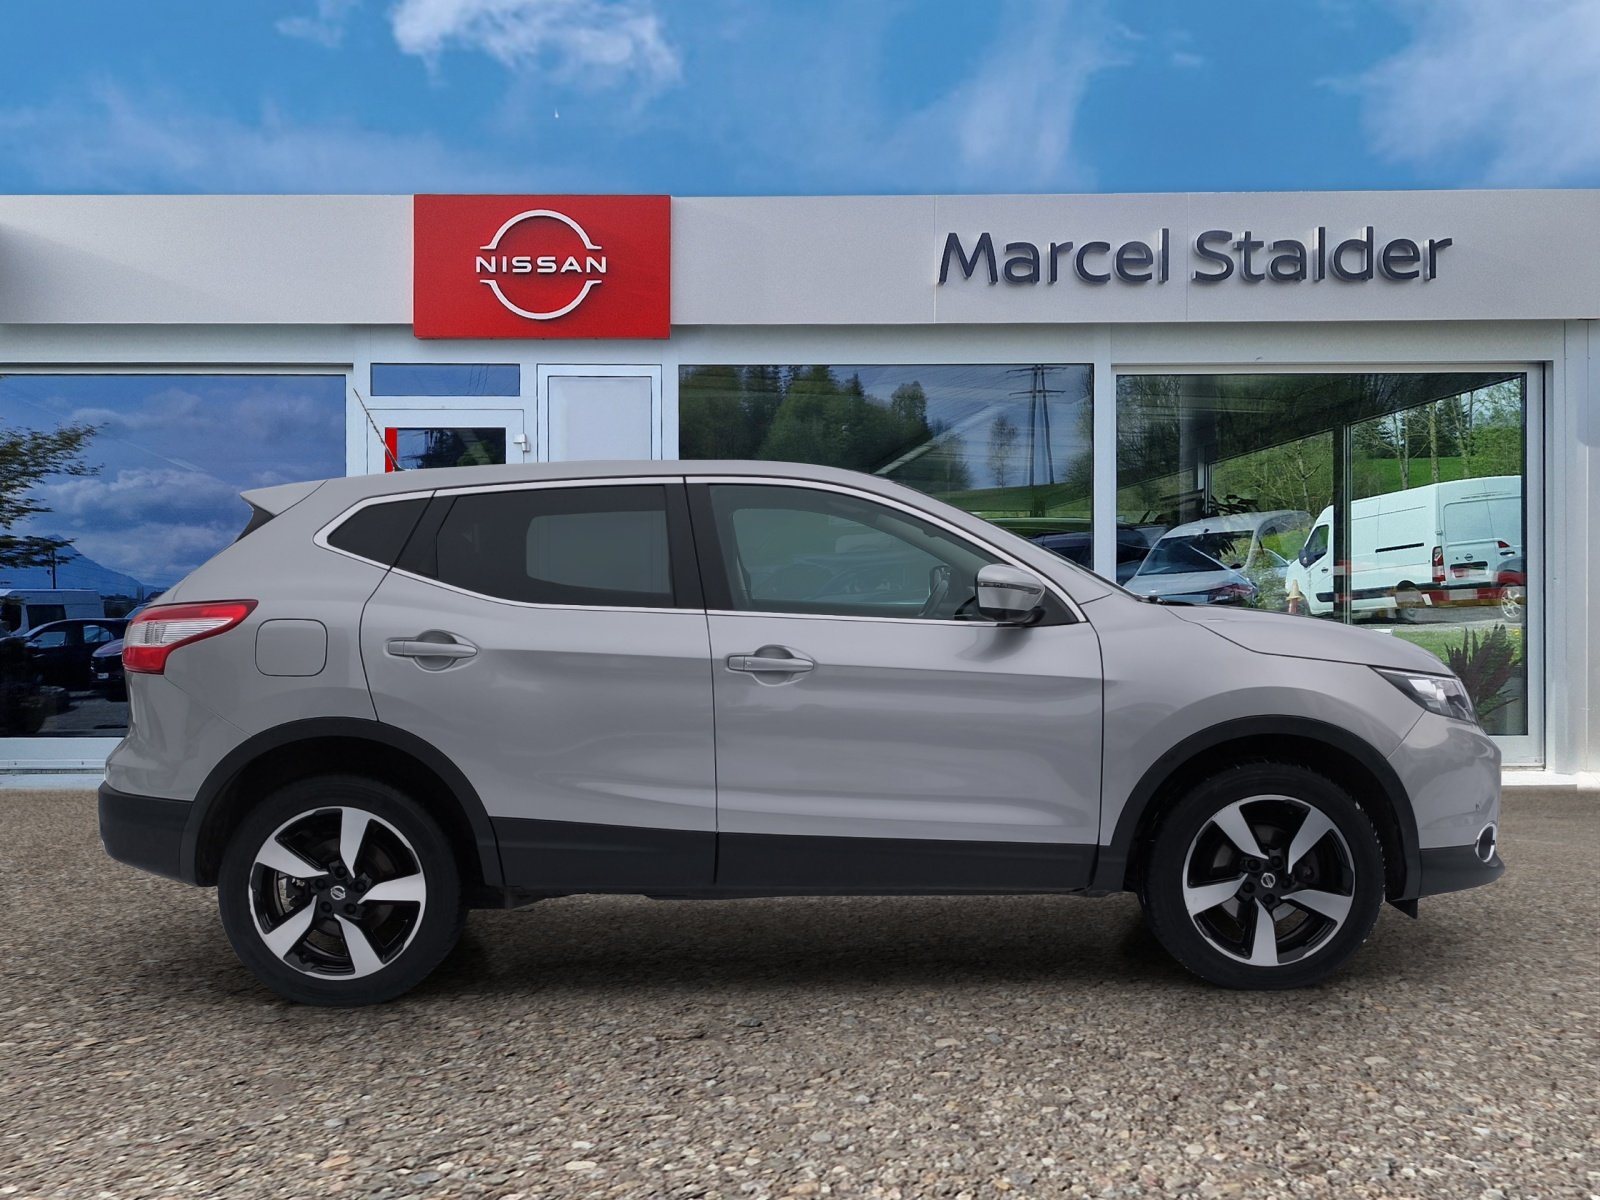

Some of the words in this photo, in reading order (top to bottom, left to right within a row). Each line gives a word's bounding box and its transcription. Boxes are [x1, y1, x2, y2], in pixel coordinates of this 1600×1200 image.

[475, 256, 607, 273] NISSAN
[937, 228, 1170, 286] Marcel
[1191, 226, 1453, 283] Stalder
